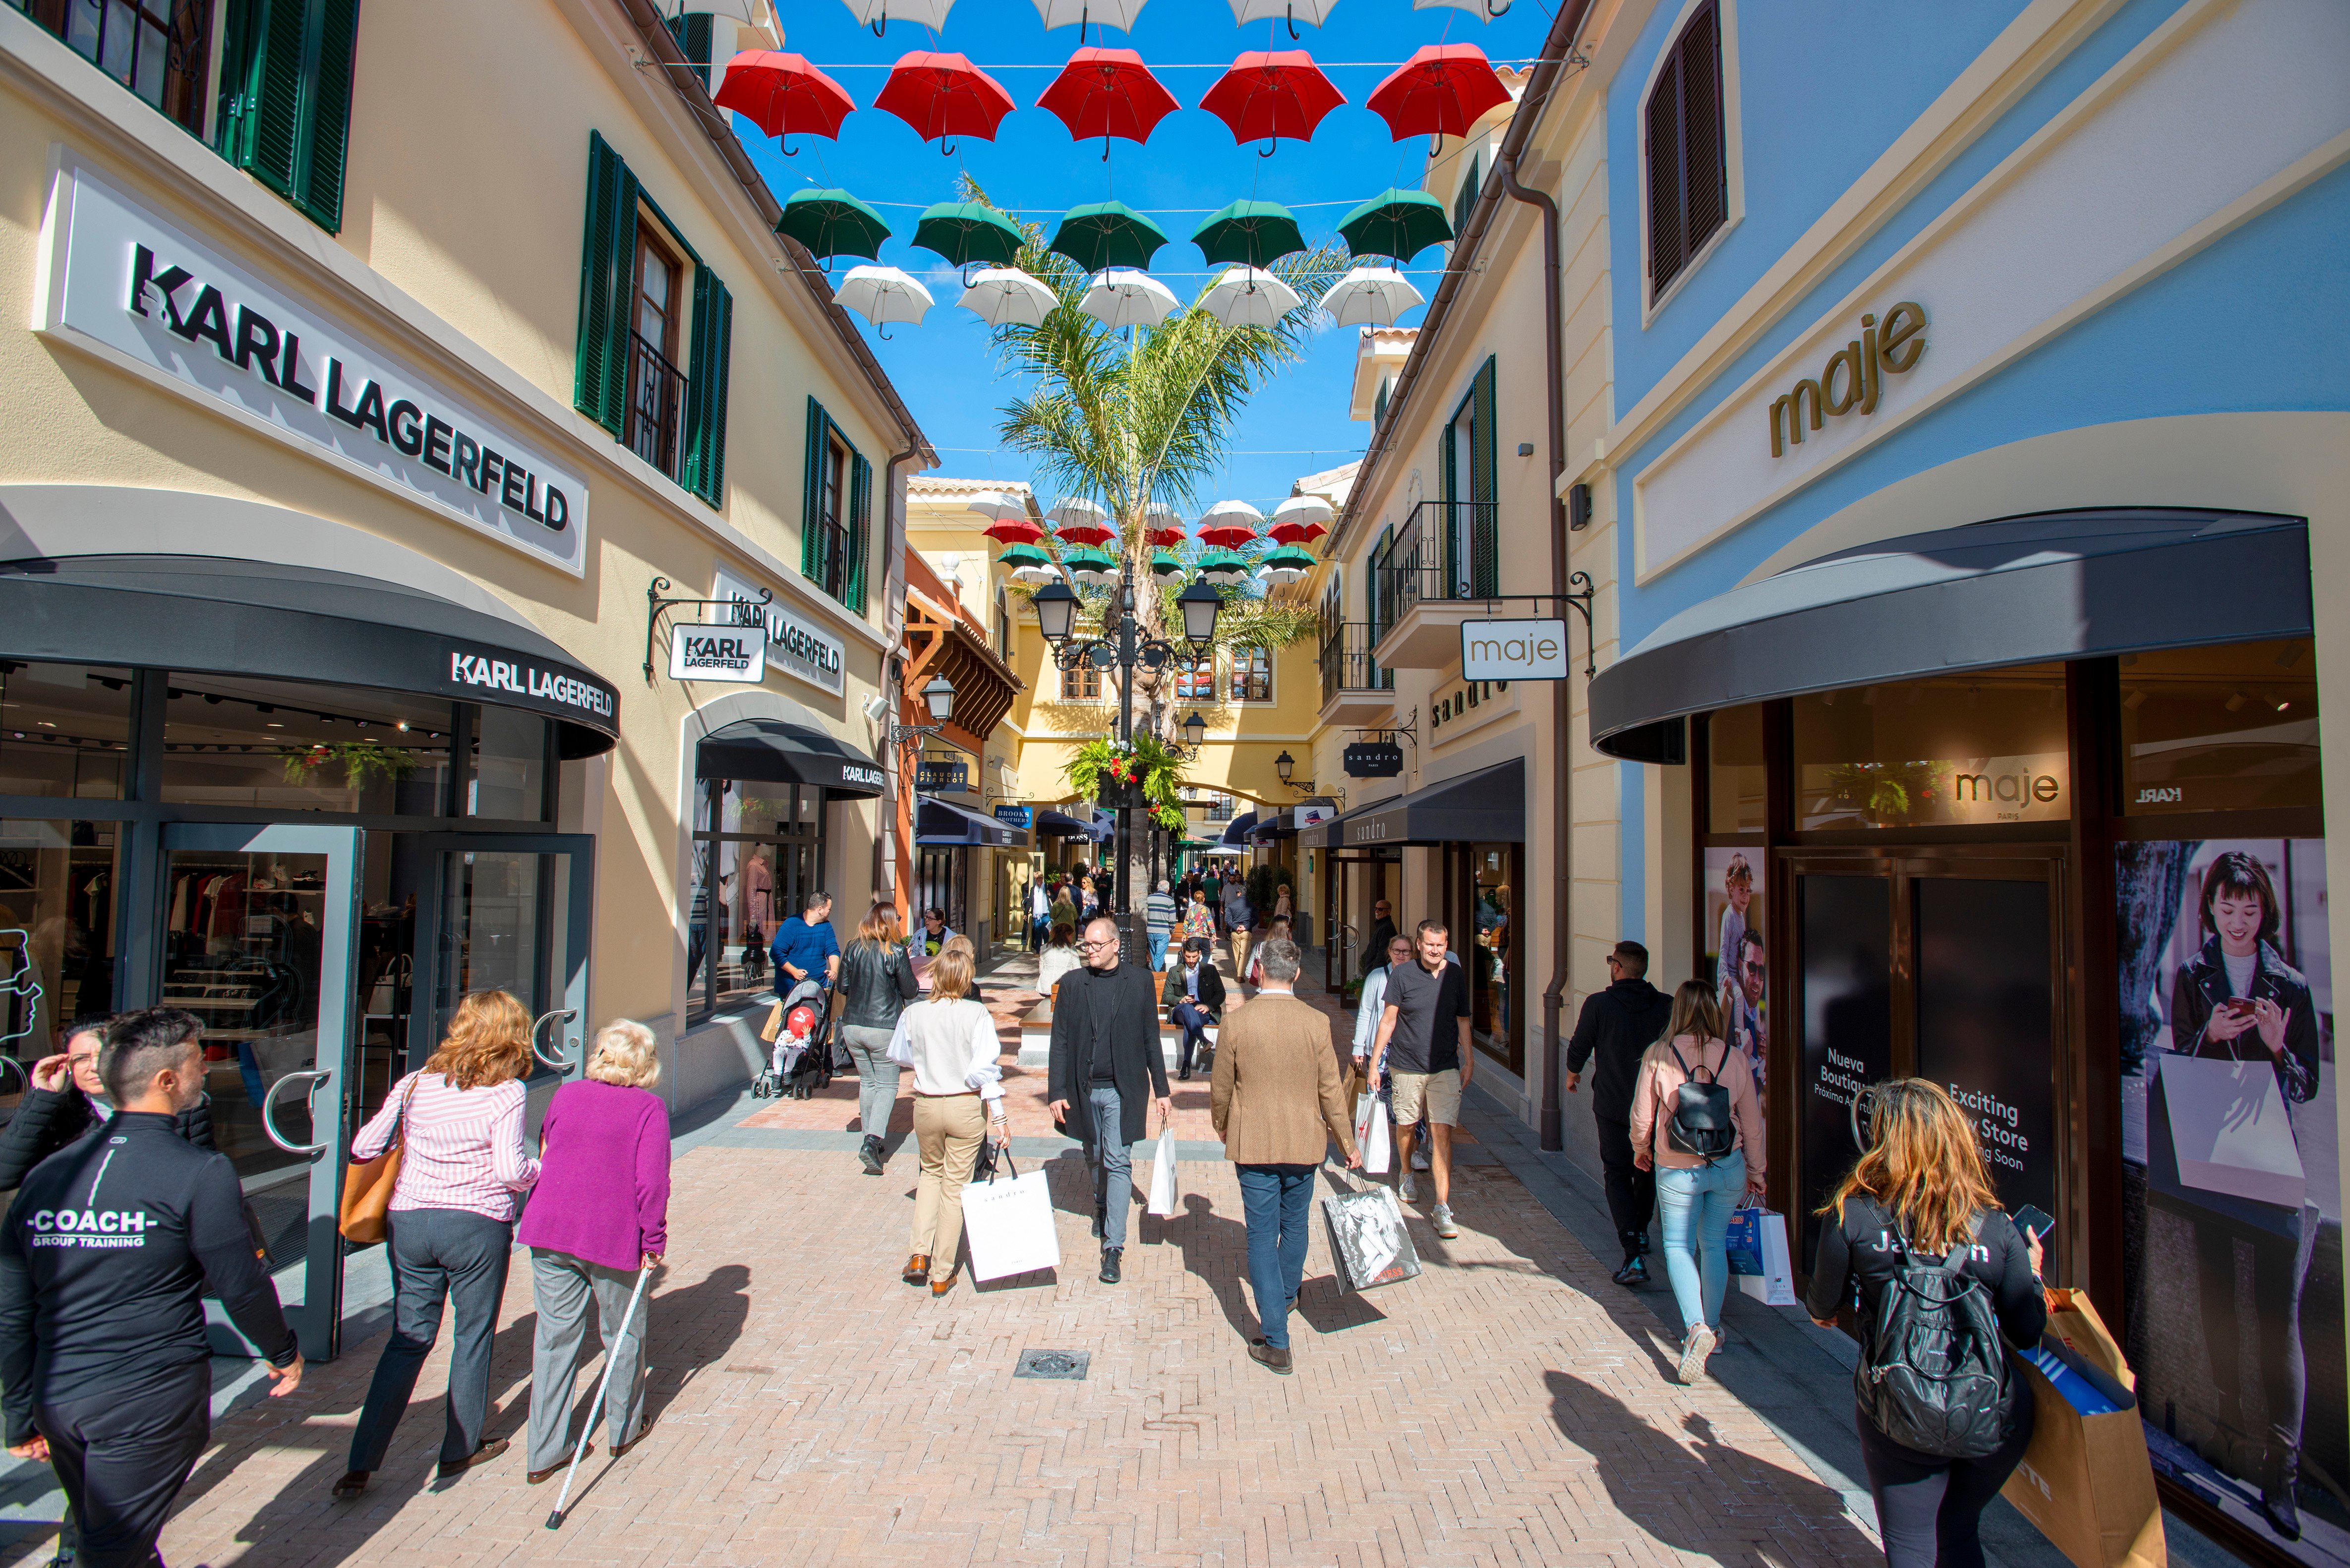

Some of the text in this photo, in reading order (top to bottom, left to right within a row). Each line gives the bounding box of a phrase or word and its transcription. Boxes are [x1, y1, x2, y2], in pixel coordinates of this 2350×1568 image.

[126, 241, 569, 531] KARL LAGERFELD
[1769, 301, 1927, 458] maje
[686, 637, 750, 659] KARL
[772, 614, 840, 675] LAGERFELD
[1471, 633, 1558, 666] maje
[684, 658, 749, 669] LAGERFELD
[452, 652, 612, 717] KARL LAGERFELD
[843, 765, 865, 782] KARL
[1955, 767, 2059, 809] maje
[1305, 831, 1319, 845] sandro
[1357, 818, 1385, 841] sandro
[1828, 1047, 1864, 1073] Nueva
[1815, 1083, 1843, 1104] Próxima
[1950, 1083, 2018, 1128] Exciting
[1982, 1118, 2029, 1152] Store
[1995, 1148, 2024, 1171] Soon
[984, 1190, 1025, 1203] sandro
[32, 1237, 145, 1248] GROUP TRAINING
